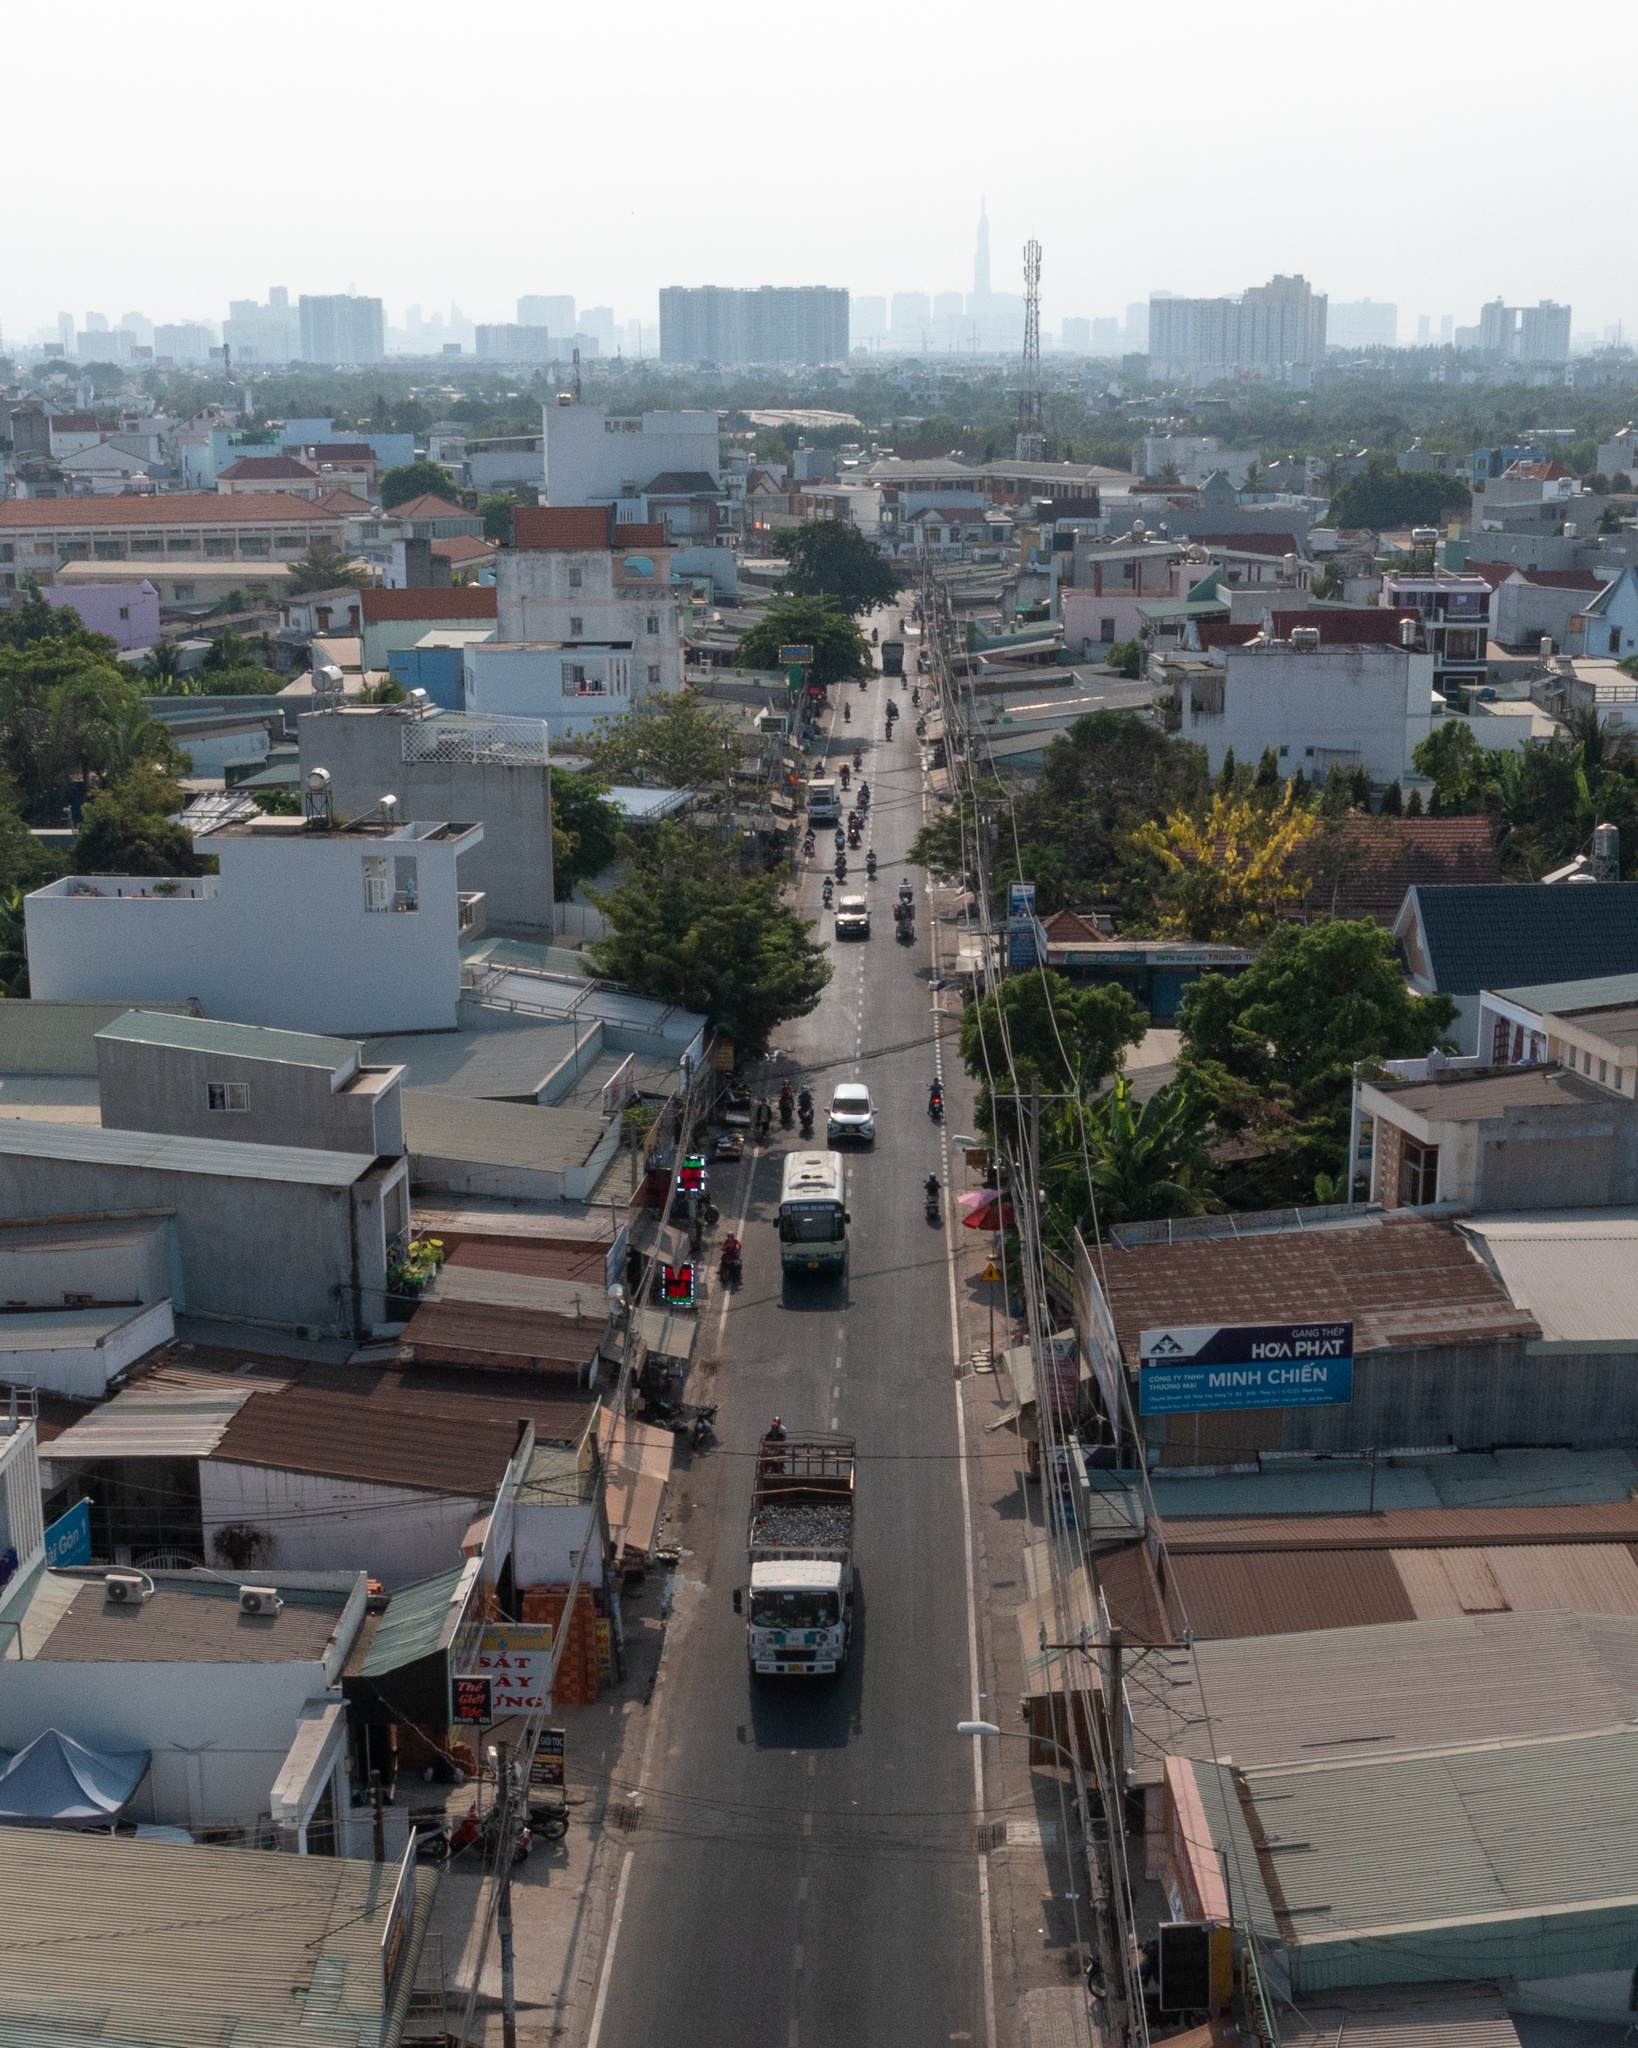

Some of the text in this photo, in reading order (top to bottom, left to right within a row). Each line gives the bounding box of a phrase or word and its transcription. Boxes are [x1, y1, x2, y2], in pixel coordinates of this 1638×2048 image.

[1292, 1326, 1345, 1338] GANG THÉP
[1252, 1339, 1344, 1358] HÒA PHÁT
[1149, 1374, 1171, 1383] CÔNG
[1184, 1373, 1204, 1381] TNHH
[1208, 1362, 1328, 1388] MINH CHIẾN
[58, 1529, 79, 1555] Gòn
[81, 1518, 86, 1536] 1
[479, 1652, 531, 1668] SẮT
[496, 1673, 533, 1687] ÂY
